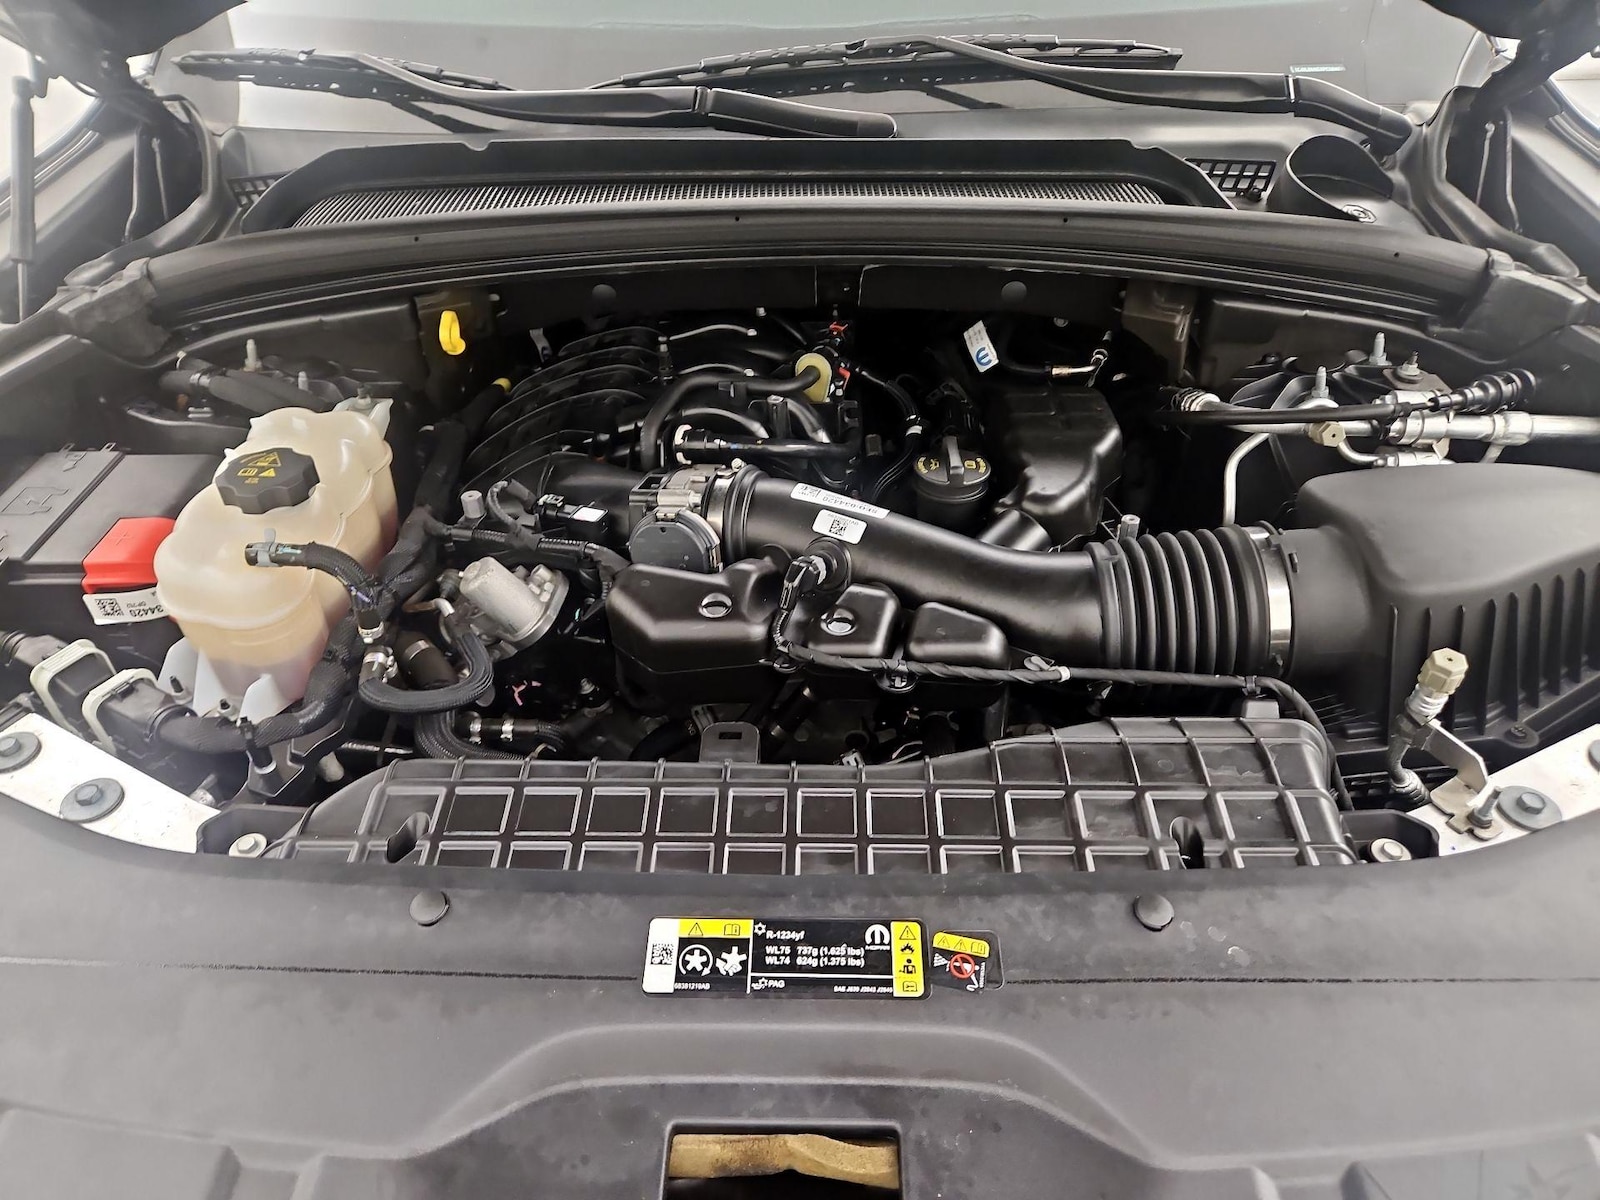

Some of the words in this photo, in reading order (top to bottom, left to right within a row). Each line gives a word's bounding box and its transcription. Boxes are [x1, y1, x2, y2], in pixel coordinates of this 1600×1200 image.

[765, 945, 791, 954] WL75
[796, 946, 818, 957] 737g
[847, 946, 865, 957] lbs)
[765, 956, 791, 965] WL74
[796, 956, 818, 967] 624g
[819, 956, 847, 967] (1.375
[847, 957, 865, 968] lbs)
[768, 980, 785, 989] PAG
